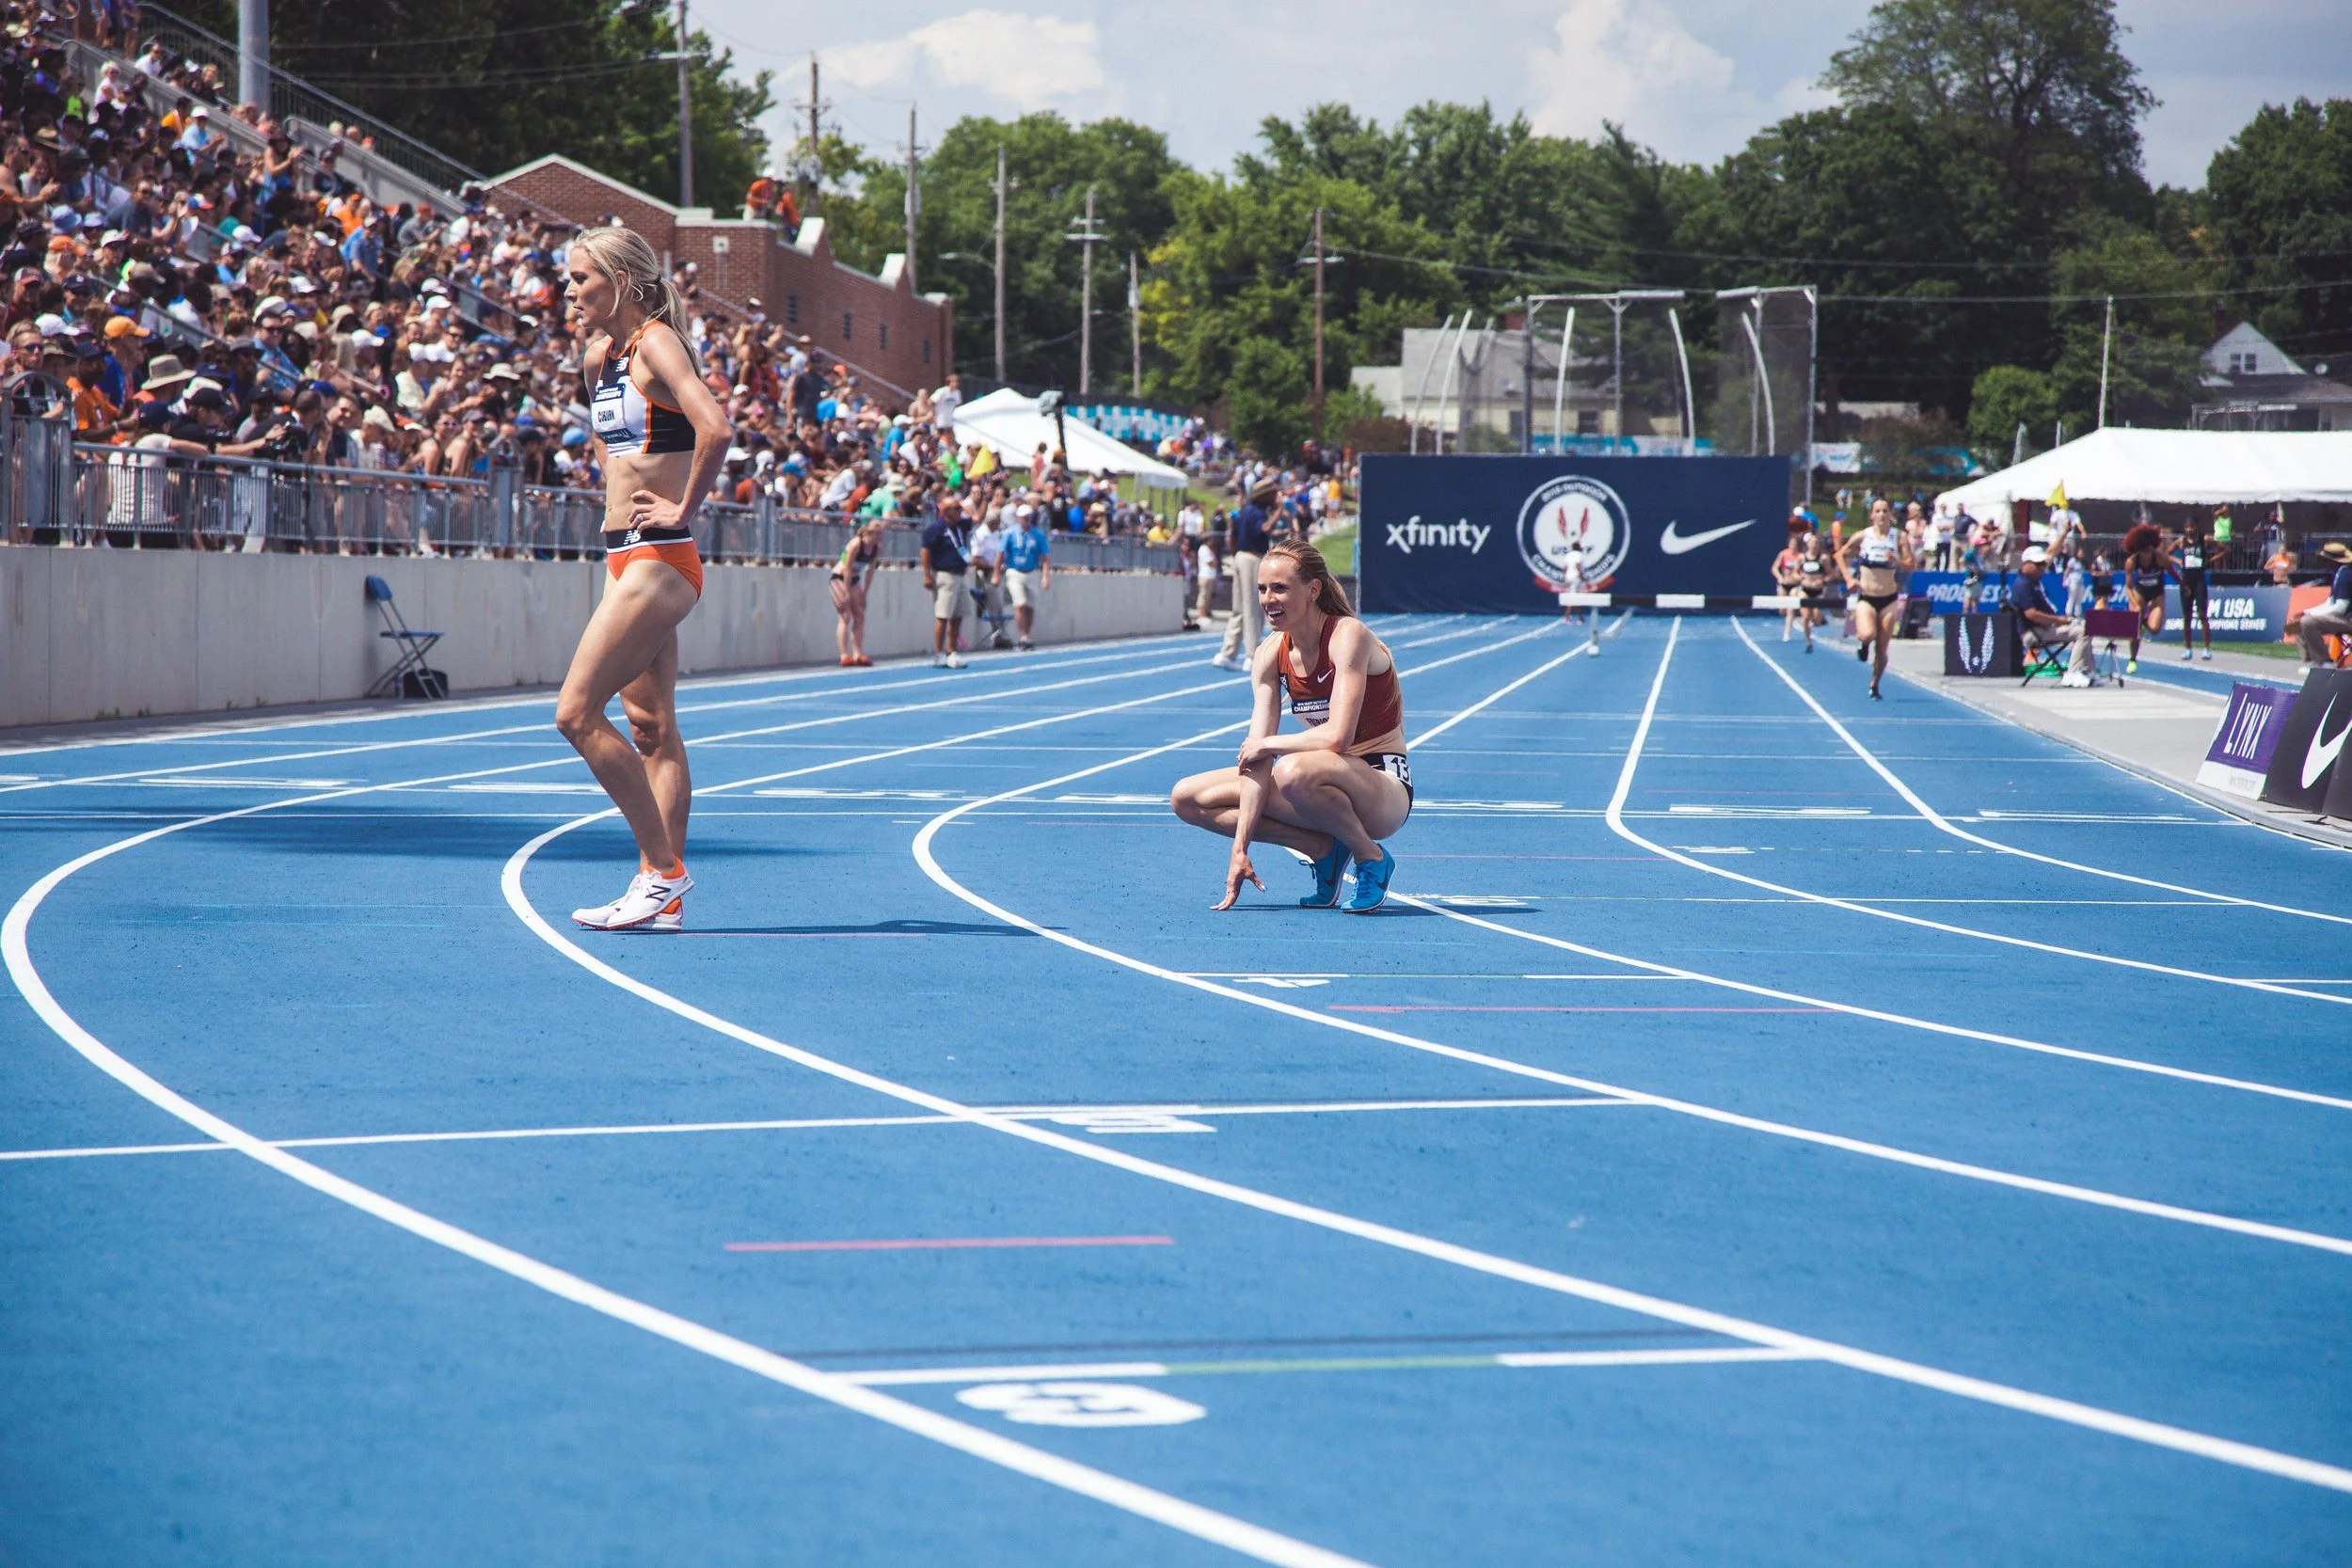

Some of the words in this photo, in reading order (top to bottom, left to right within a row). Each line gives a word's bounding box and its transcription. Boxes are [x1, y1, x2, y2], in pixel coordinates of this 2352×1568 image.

[1386, 515, 1491, 554] xfinity
[2223, 598, 2255, 618] USA
[2223, 692, 2272, 759] LYNX
[1391, 757, 1409, 782] 13
